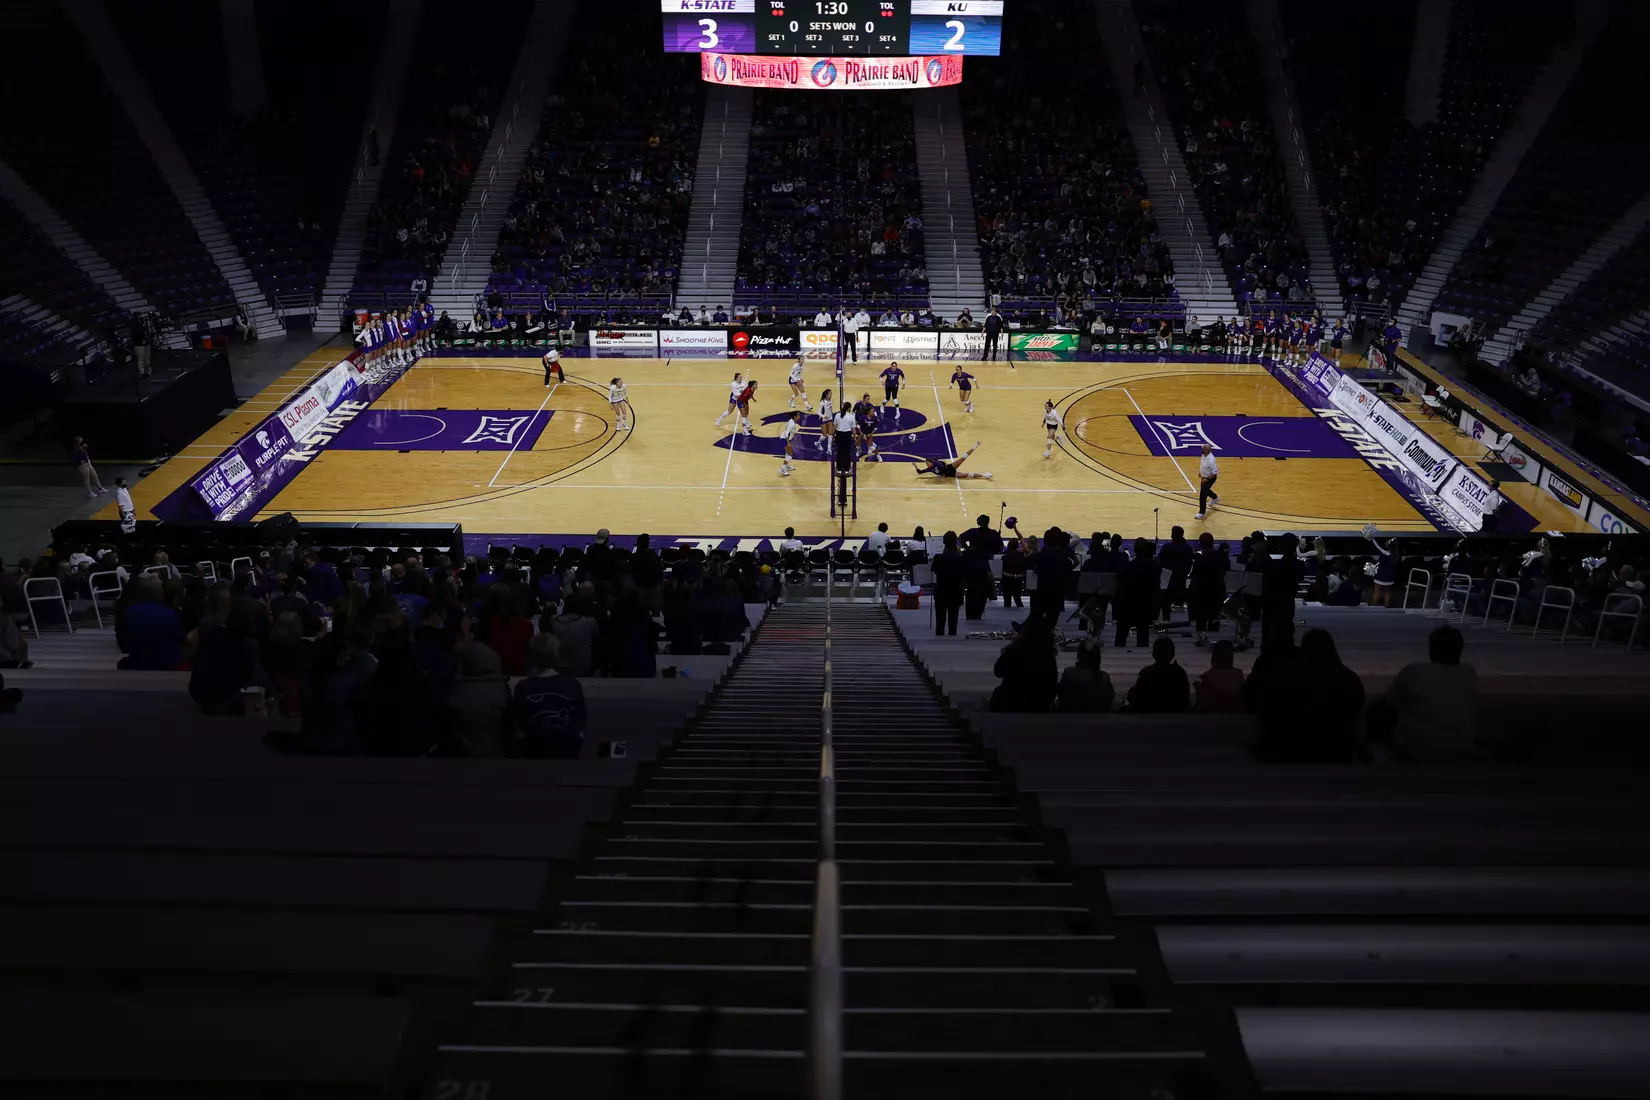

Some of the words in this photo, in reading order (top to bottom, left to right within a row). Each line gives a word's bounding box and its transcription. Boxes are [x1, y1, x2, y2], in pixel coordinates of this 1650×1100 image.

[681, 0, 736, 9] K-STATE
[815, 2, 848, 15] 1:30
[947, 3, 968, 12] KU
[698, 18, 719, 49] 3
[789, 21, 799, 32] 0
[809, 22, 831, 30] SETS
[833, 22, 856, 30] WON
[865, 22, 874, 33] 0
[943, 20, 965, 50] 2
[731, 58, 766, 81] PRAIRIE
[769, 59, 799, 84] BAND
[845, 60, 888, 85] PRAIRIE
[892, 60, 919, 84] BAND
[749, 335, 775, 345] Pizza
[775, 335, 793, 345] Hut
[283, 412, 300, 428] CSL
[294, 396, 319, 420] Plasma
[281, 399, 370, 462] K-STATE
[1312, 407, 1402, 470] K-STATE
[255, 442, 281, 467] PURPLE
[277, 435, 289, 449] PIT
[202, 469, 223, 490] DRIVE
[207, 480, 227, 499] WITH
[1549, 473, 1582, 505] KANSASLAND
[214, 486, 237, 508] PRIDE!
[1451, 488, 1469, 505] CAMPUS
[1466, 502, 1483, 516] STORE
[511, 987, 555, 1004] 27
